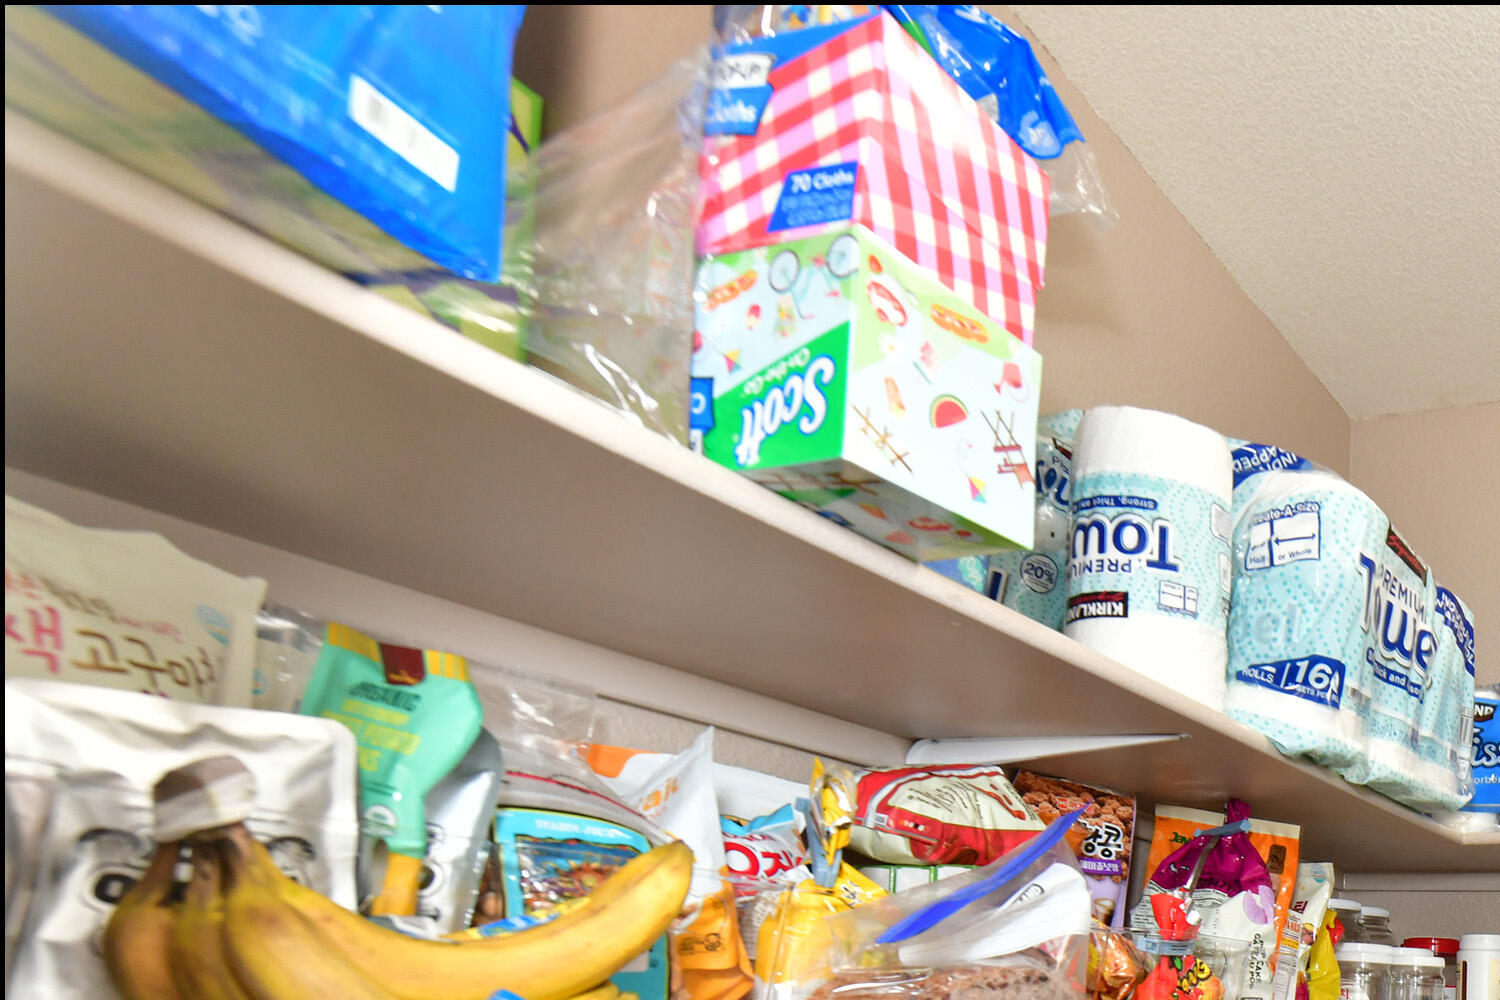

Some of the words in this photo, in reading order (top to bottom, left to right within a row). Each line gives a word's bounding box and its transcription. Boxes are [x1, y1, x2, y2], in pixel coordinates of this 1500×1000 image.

[791, 175, 811, 194] 70
[813, 171, 855, 192] Cloths
[734, 354, 836, 468] Scott
[1026, 562, 1054, 584] 20%
